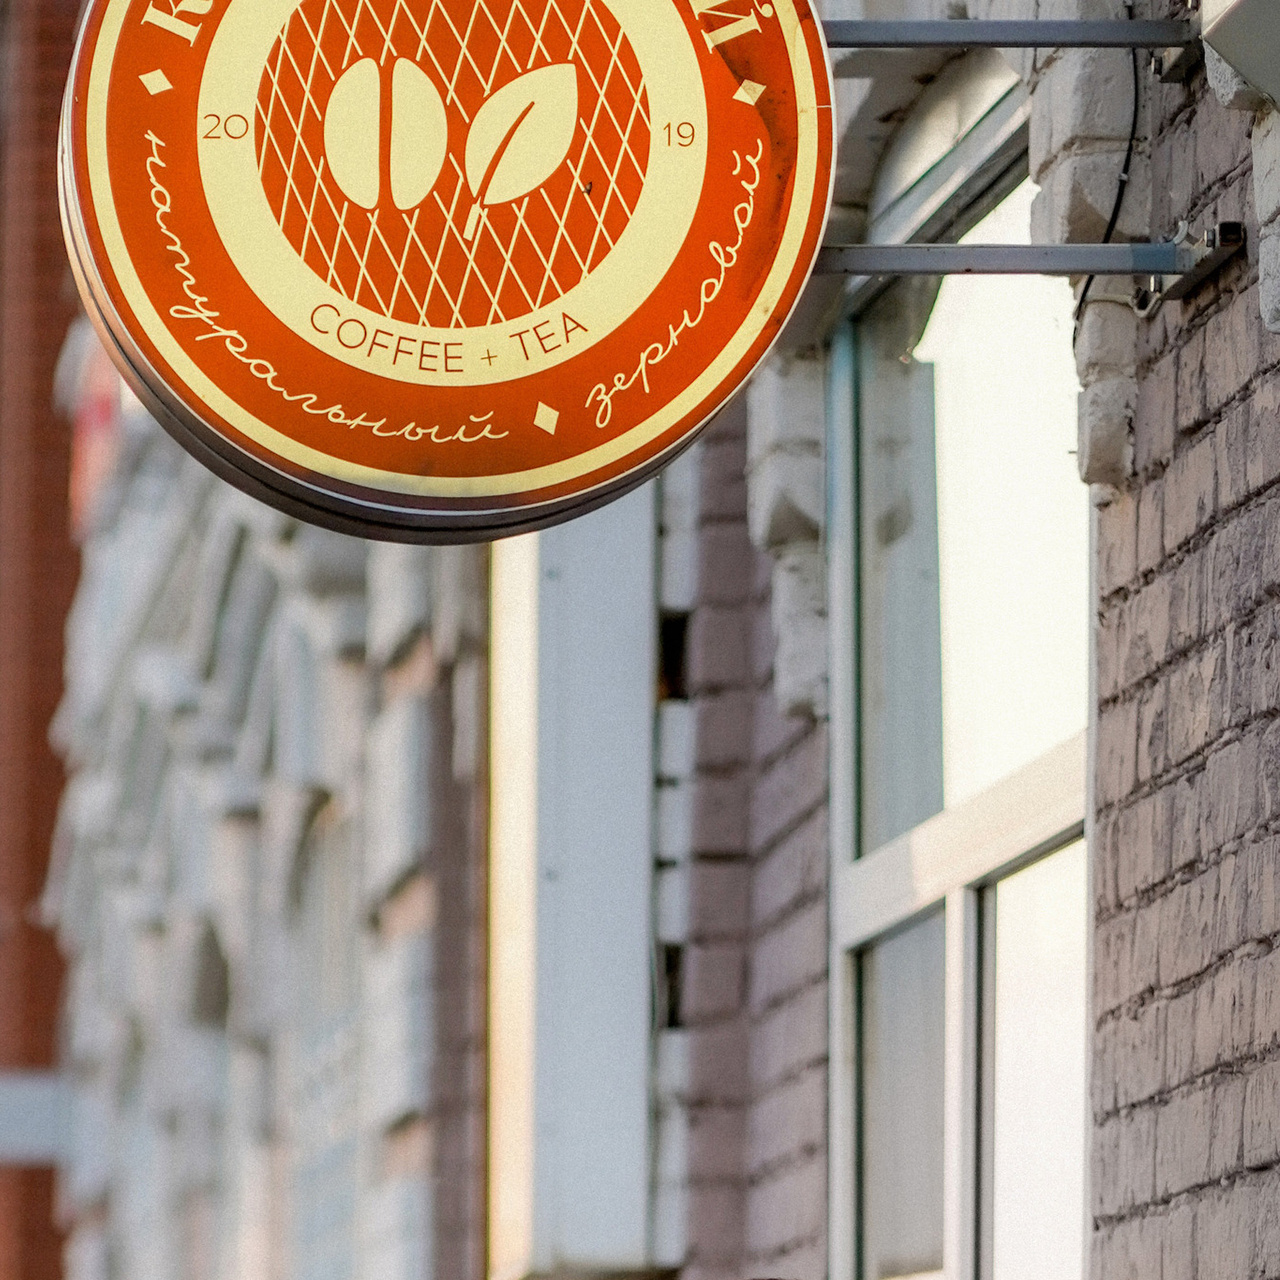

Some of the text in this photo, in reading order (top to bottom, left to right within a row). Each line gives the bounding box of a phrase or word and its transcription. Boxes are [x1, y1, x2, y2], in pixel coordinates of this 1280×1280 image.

[203, 114, 249, 139] 20
[663, 122, 695, 147] 19
[144, 129, 763, 443] натуральный зерновой
[310, 303, 464, 373] COFFEE
[509, 312, 588, 361] TEA
